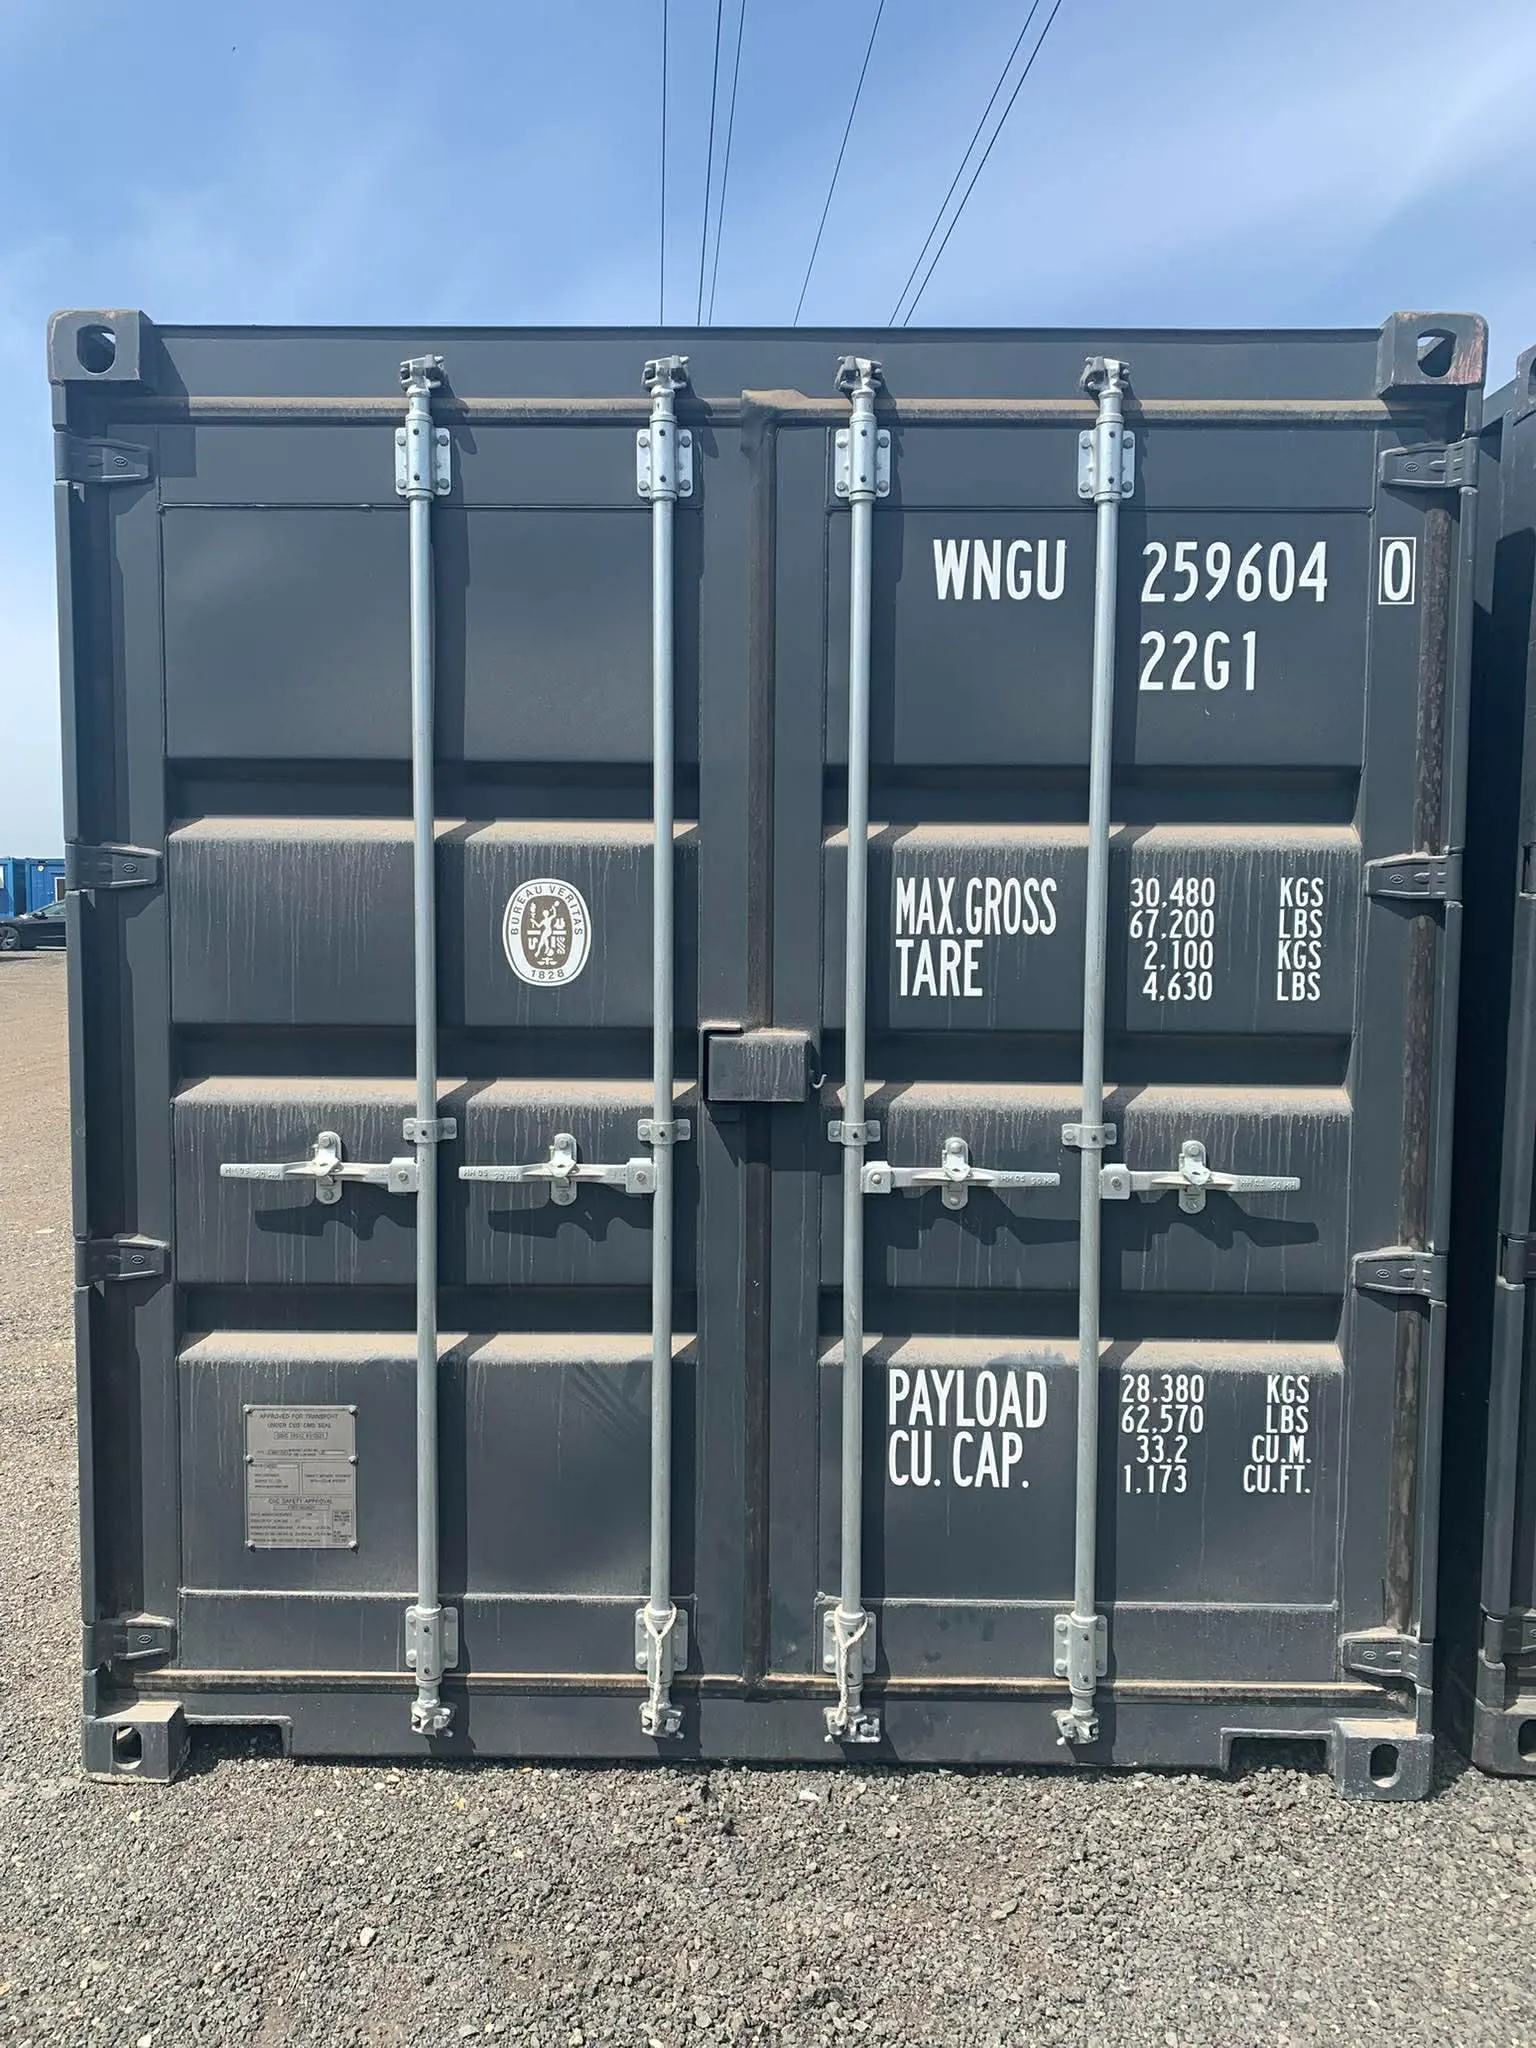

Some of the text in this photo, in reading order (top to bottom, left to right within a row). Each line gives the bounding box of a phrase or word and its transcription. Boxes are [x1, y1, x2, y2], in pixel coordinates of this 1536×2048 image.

[933, 539, 1412, 603] WNGU 259604 0
[1139, 630, 1256, 691] 22G1
[895, 876, 1058, 936] MAX.GROSS
[1130, 877, 1324, 908] 30,480 KGS
[510, 885, 583, 936] BUREAU VERITAS
[1278, 908, 1323, 939] LBS
[895, 938, 984, 997] TARE
[1277, 939, 1322, 970] KGS
[531, 969, 565, 980] 1828
[1276, 971, 1321, 1001] LBS
[888, 1368, 1048, 1428] PAYLOAD
[1266, 1374, 1310, 1404] KGS
[1266, 1404, 1309, 1434] LBS
[888, 1429, 1030, 1489] CU. CAP.
[1136, 1434, 1313, 1464] 33.2 CU.M.
[1123, 1464, 1312, 1495] 1,173 CU.FT.
